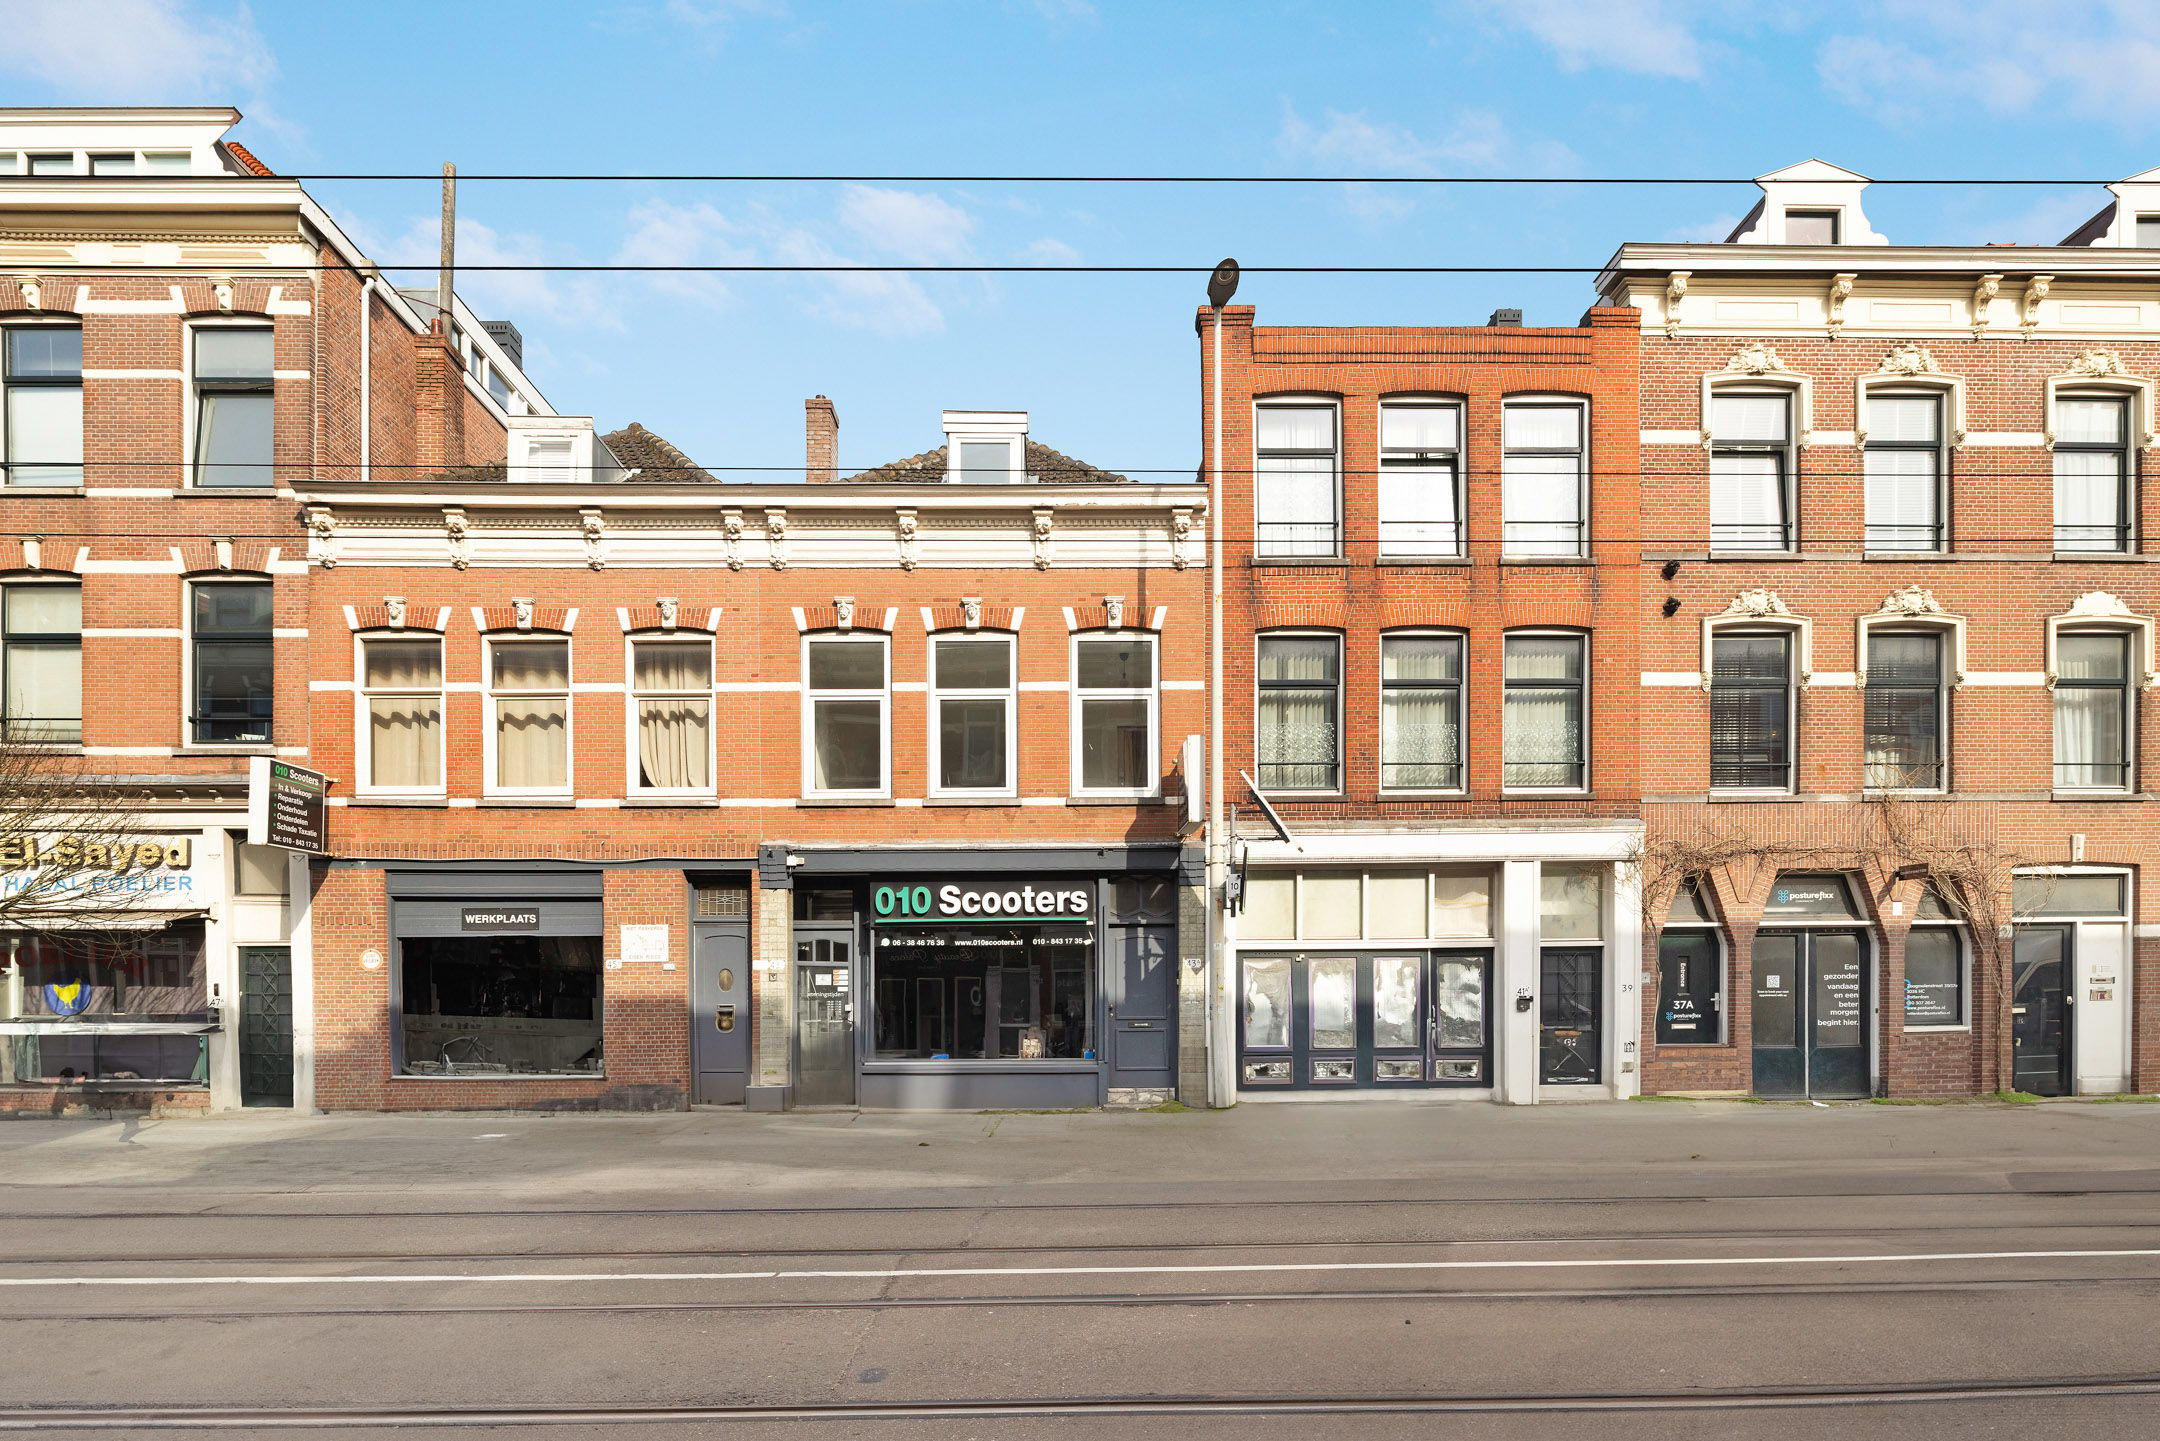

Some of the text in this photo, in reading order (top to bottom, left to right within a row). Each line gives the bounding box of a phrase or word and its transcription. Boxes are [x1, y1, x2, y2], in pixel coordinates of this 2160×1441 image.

[275, 765, 319, 785] 010 Scooters
[290, 787, 312, 799] Verkoop
[277, 793, 304, 806] Reparatie
[277, 803, 308, 816] Onderhoud
[276, 813, 309, 826] Onderdelen
[276, 822, 318, 837] Schade Taxatie
[283, 836, 293, 844] 010
[295, 839, 305, 847] 843
[305, 840, 312, 848] 17
[5, 876, 193, 891] HALAL POELIER
[1230, 882, 1239, 891] 10
[874, 885, 1089, 915] 010 Scooters
[1789, 890, 1834, 900] posturefixx
[464, 914, 537, 924] WERKPLAATS
[1823, 973, 1859, 981] gezonder
[1622, 984, 1633, 992] 39
[1827, 983, 1859, 991] vandaag
[1673, 1000, 1694, 1010] 37A
[1817, 1019, 1842, 1027] begint
